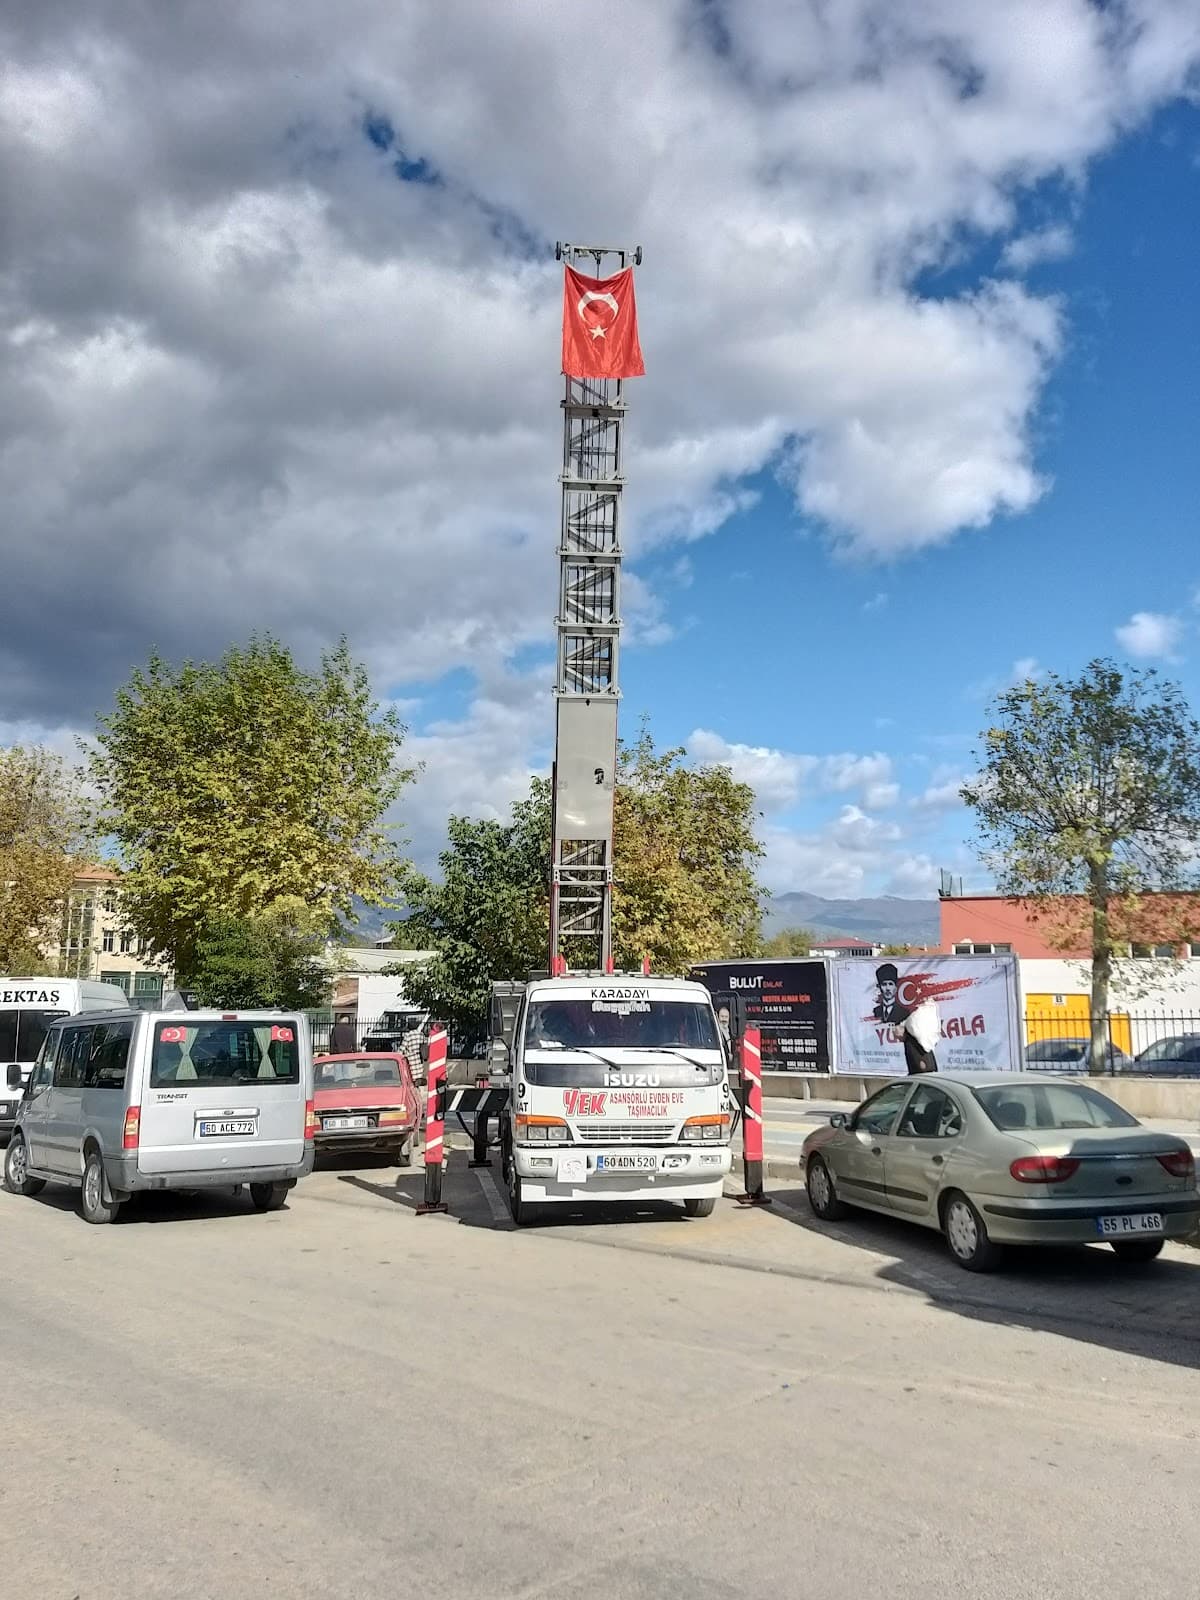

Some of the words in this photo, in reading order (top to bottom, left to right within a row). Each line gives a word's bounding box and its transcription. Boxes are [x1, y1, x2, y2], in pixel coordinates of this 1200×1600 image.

[729, 976, 763, 989] BULUT
[0, 990, 60, 1006] EKTAŞ
[591, 989, 649, 999] KARADAYI
[603, 1073, 661, 1087] ISUZU
[518, 1083, 526, 1098] 9
[722, 1083, 729, 1098] 9
[564, 1088, 608, 1116] YEK
[650, 1092, 670, 1104] EVDEN
[672, 1092, 684, 1104] EVE
[517, 1102, 528, 1112] AT
[628, 1105, 668, 1118] TAŞIMACILIK
[220, 1124, 235, 1133] ACE
[236, 1122, 253, 1132] 772
[604, 1157, 616, 1168] 60
[618, 1157, 635, 1168] ADN
[637, 1157, 655, 1168] 520
[1104, 1218, 1117, 1231] 55
[1122, 1217, 1136, 1230] PL
[1141, 1215, 1160, 1228] 466
